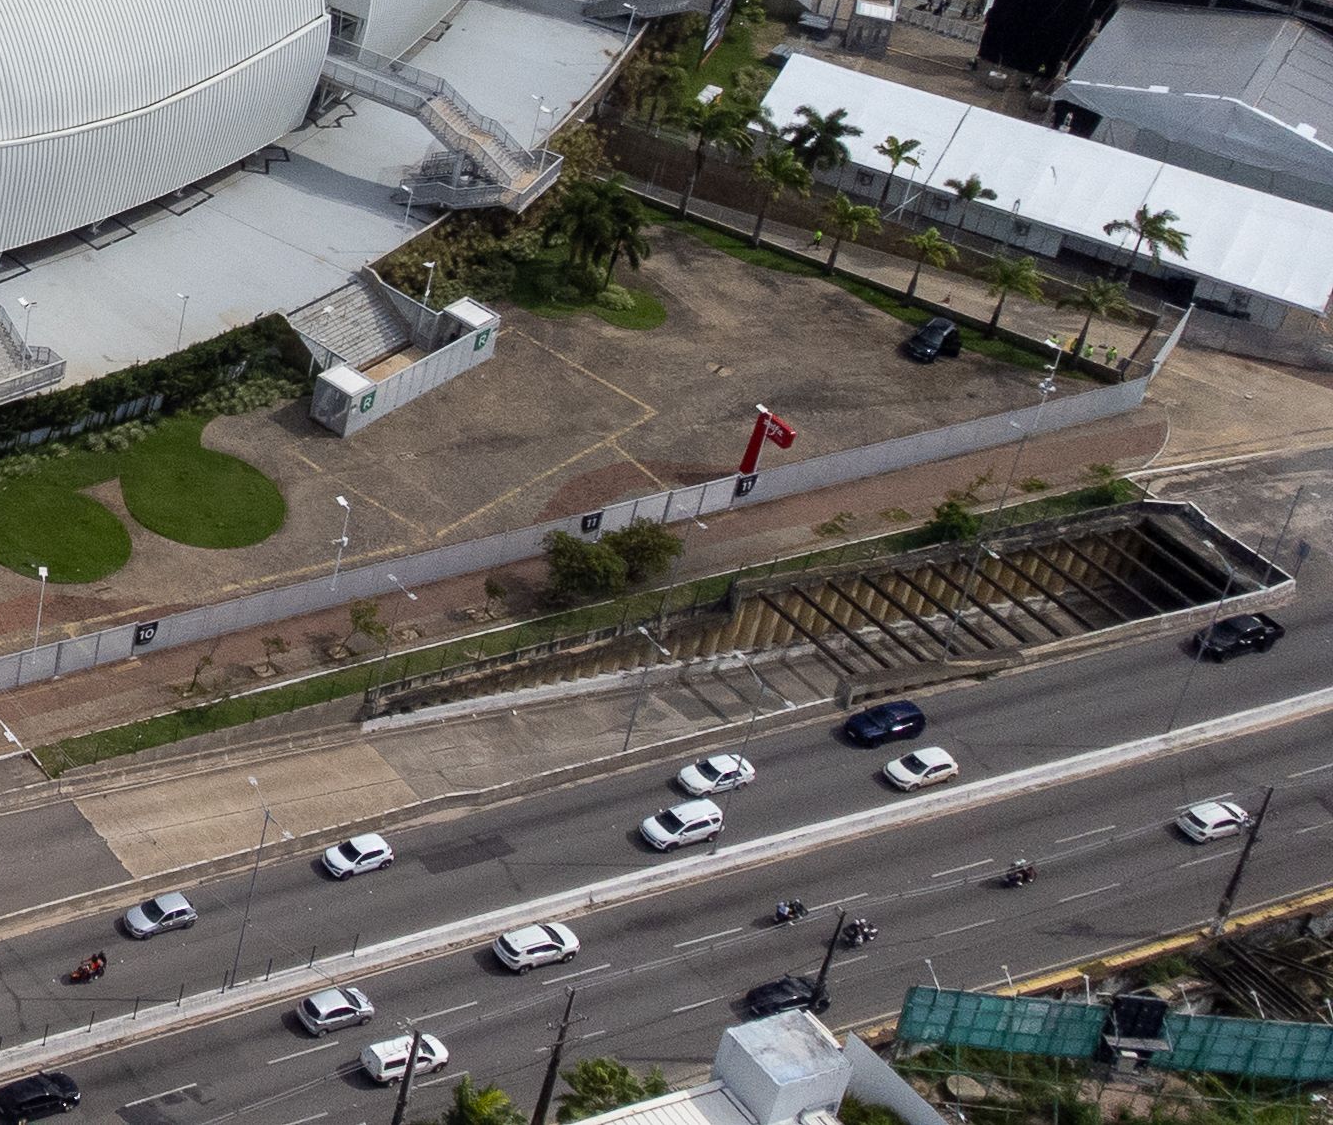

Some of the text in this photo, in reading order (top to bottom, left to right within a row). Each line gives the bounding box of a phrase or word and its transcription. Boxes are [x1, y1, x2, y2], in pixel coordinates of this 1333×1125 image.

[478, 334, 488, 347] R
[363, 396, 373, 408] R
[742, 481, 753, 491] 11
[586, 517, 598, 529] 11
[139, 628, 154, 640] 10
